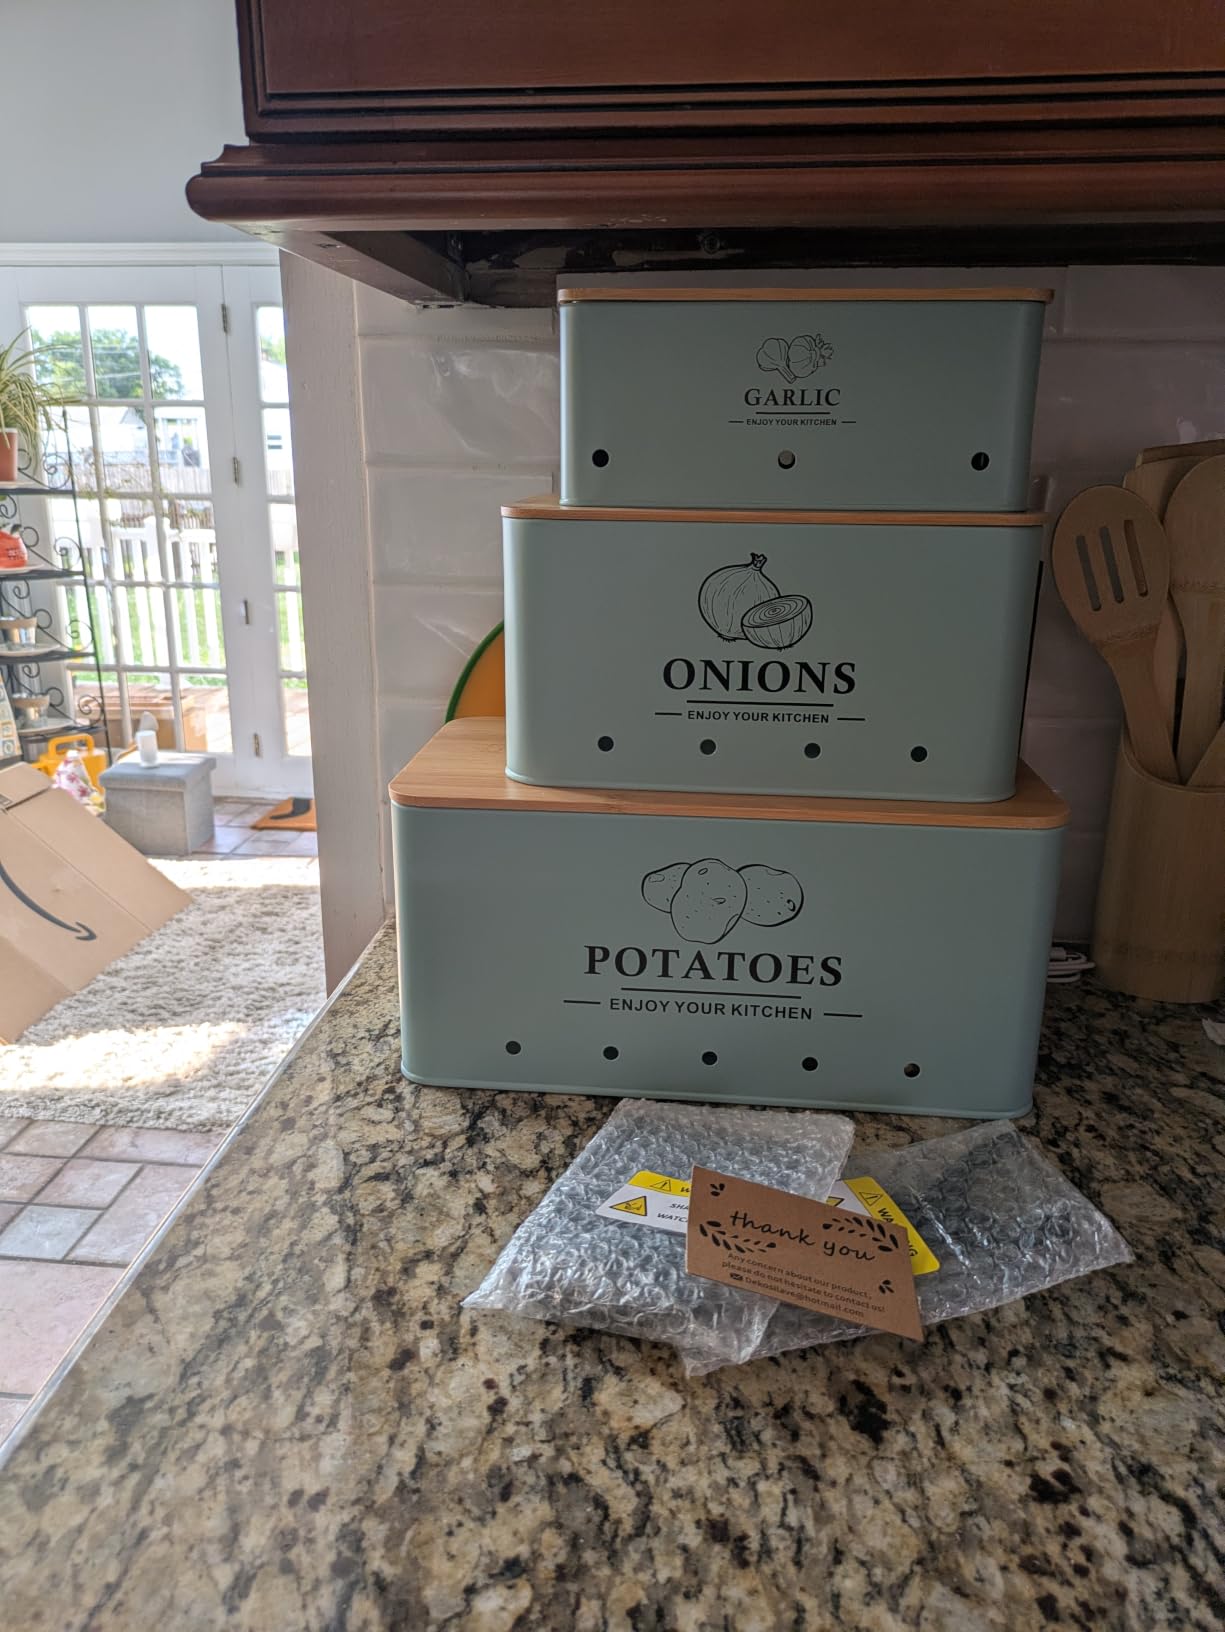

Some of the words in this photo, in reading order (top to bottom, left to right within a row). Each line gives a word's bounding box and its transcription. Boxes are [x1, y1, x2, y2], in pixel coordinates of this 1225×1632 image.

[744, 388, 841, 406] GARLIC
[747, 418, 774, 426] ENJOY
[775, 418, 799, 426] YOUR
[800, 418, 837, 426] KITCHEN
[663, 658, 856, 694] ONIONS
[687, 710, 731, 721] ENJOY
[732, 711, 769, 722] YOUR
[772, 712, 829, 723] KITCHEN
[584, 945, 842, 986] POTATOES
[610, 998, 670, 1012] ENJOY
[675, 1001, 726, 1015] YOUR
[731, 1003, 812, 1020] KITCHEN
[657, 1213, 688, 1222] WATC
[729, 1210, 815, 1246] thank
[823, 1239, 875, 1261] you
[727, 1253, 745, 1263] Any
[746, 1259, 784, 1274] concern
[785, 1270, 812, 1282] about
[813, 1278, 829, 1287] our
[722, 1261, 752, 1274] please
[753, 1270, 766, 1279] do
[767, 1274, 783, 1283] not
[784, 1279, 822, 1295] hesitate
[823, 1290, 833, 1298] to
[835, 1294, 870, 1309] contact
